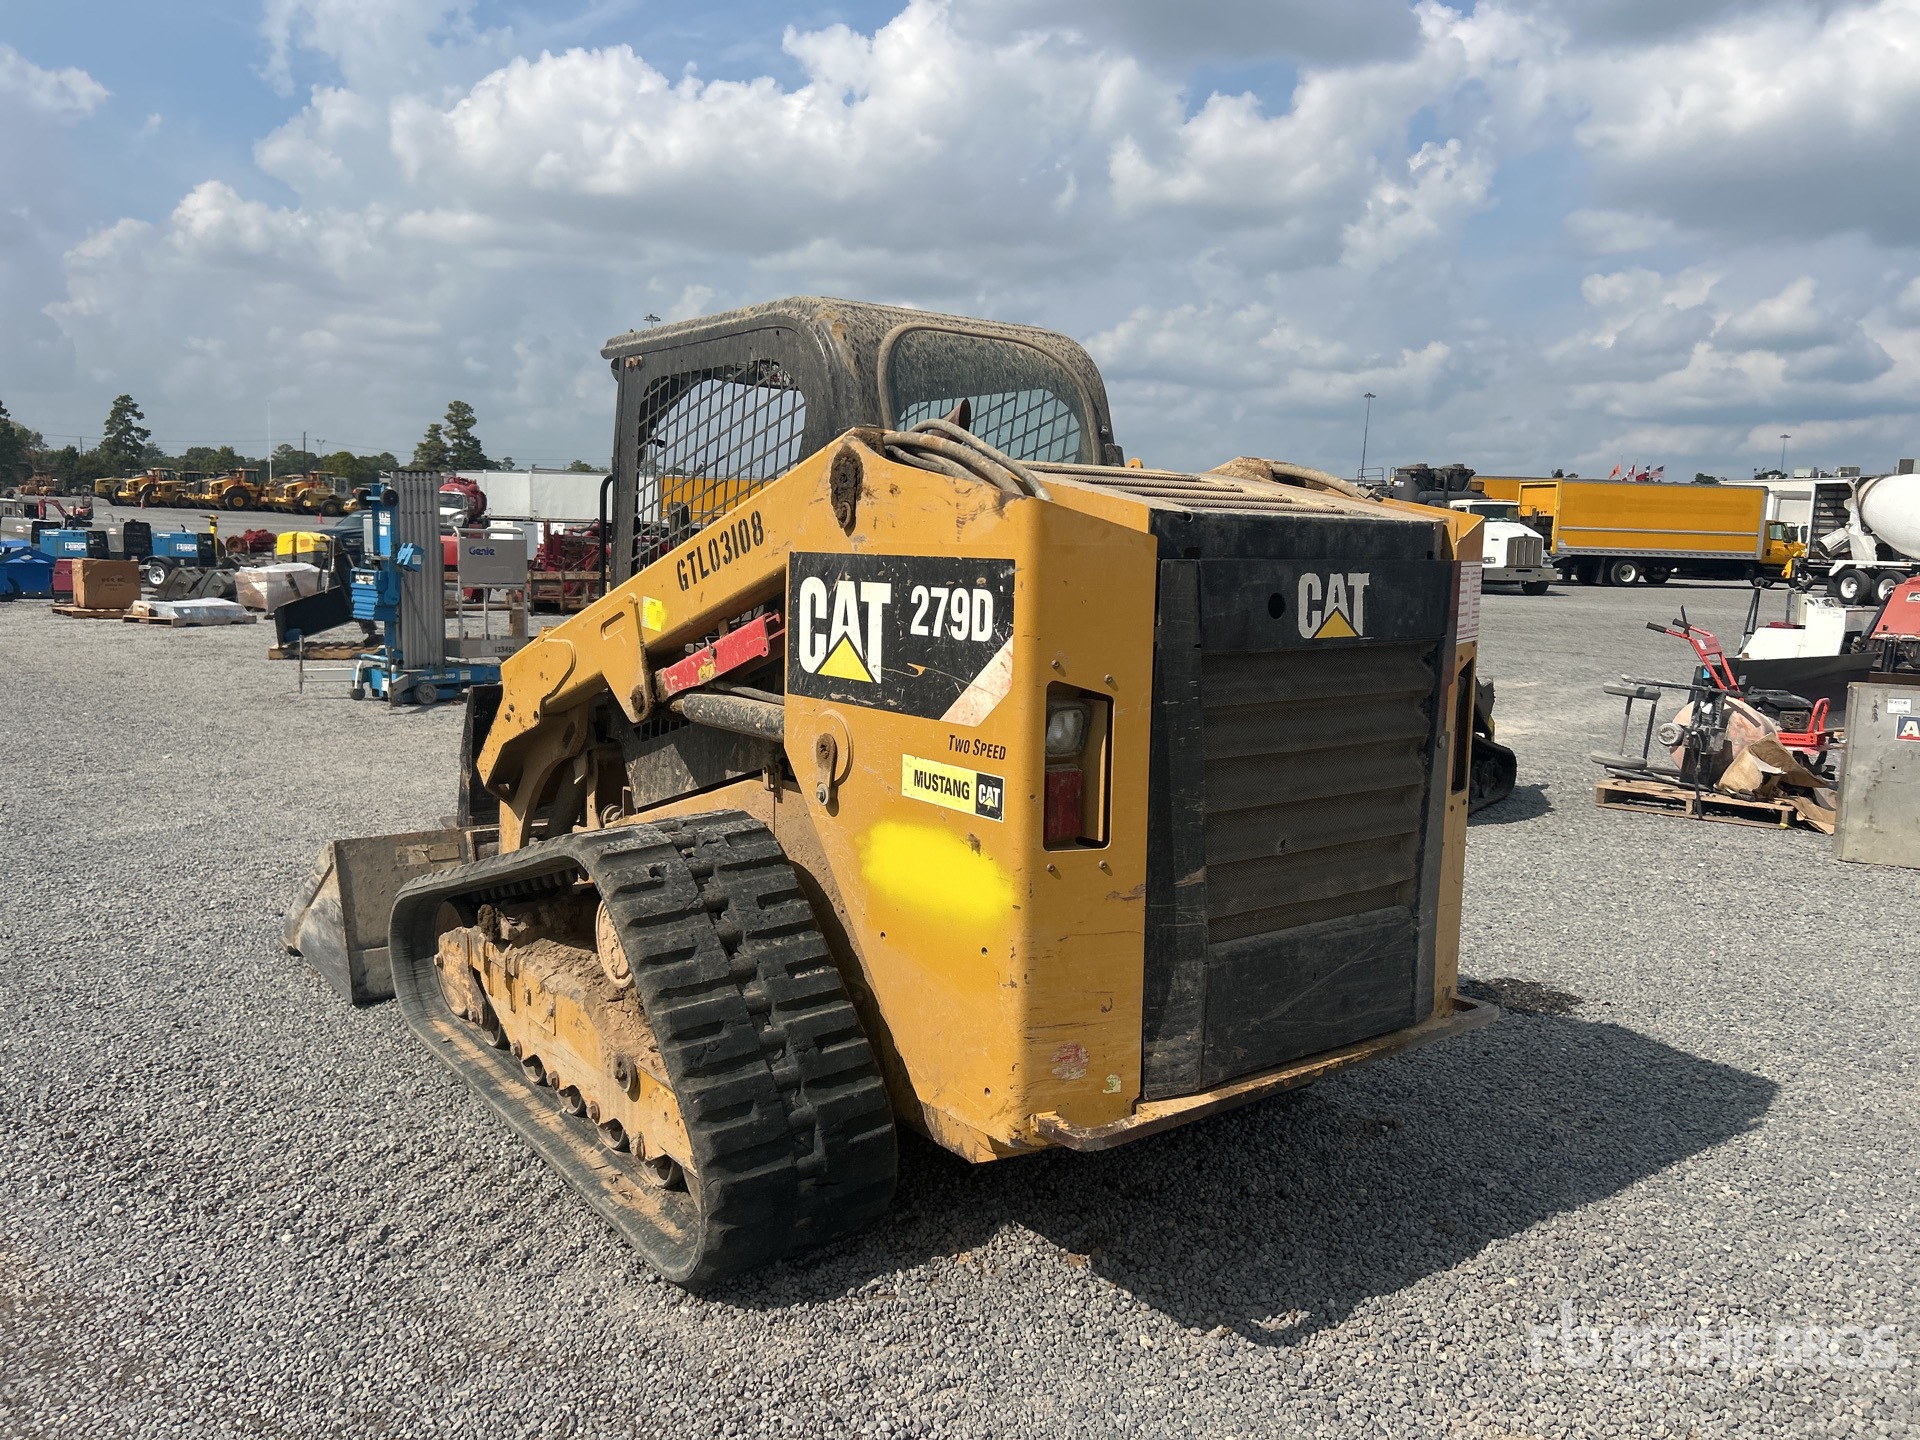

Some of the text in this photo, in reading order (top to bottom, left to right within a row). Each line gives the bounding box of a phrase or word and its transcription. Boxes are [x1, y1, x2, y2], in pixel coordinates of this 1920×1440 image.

[469, 546, 496, 556] Genie
[676, 510, 764, 592] GTL03108
[798, 576, 993, 684] CAT 279D
[1297, 572, 1370, 640] CAT
[913, 769, 1001, 808] MUSTANG CAT
